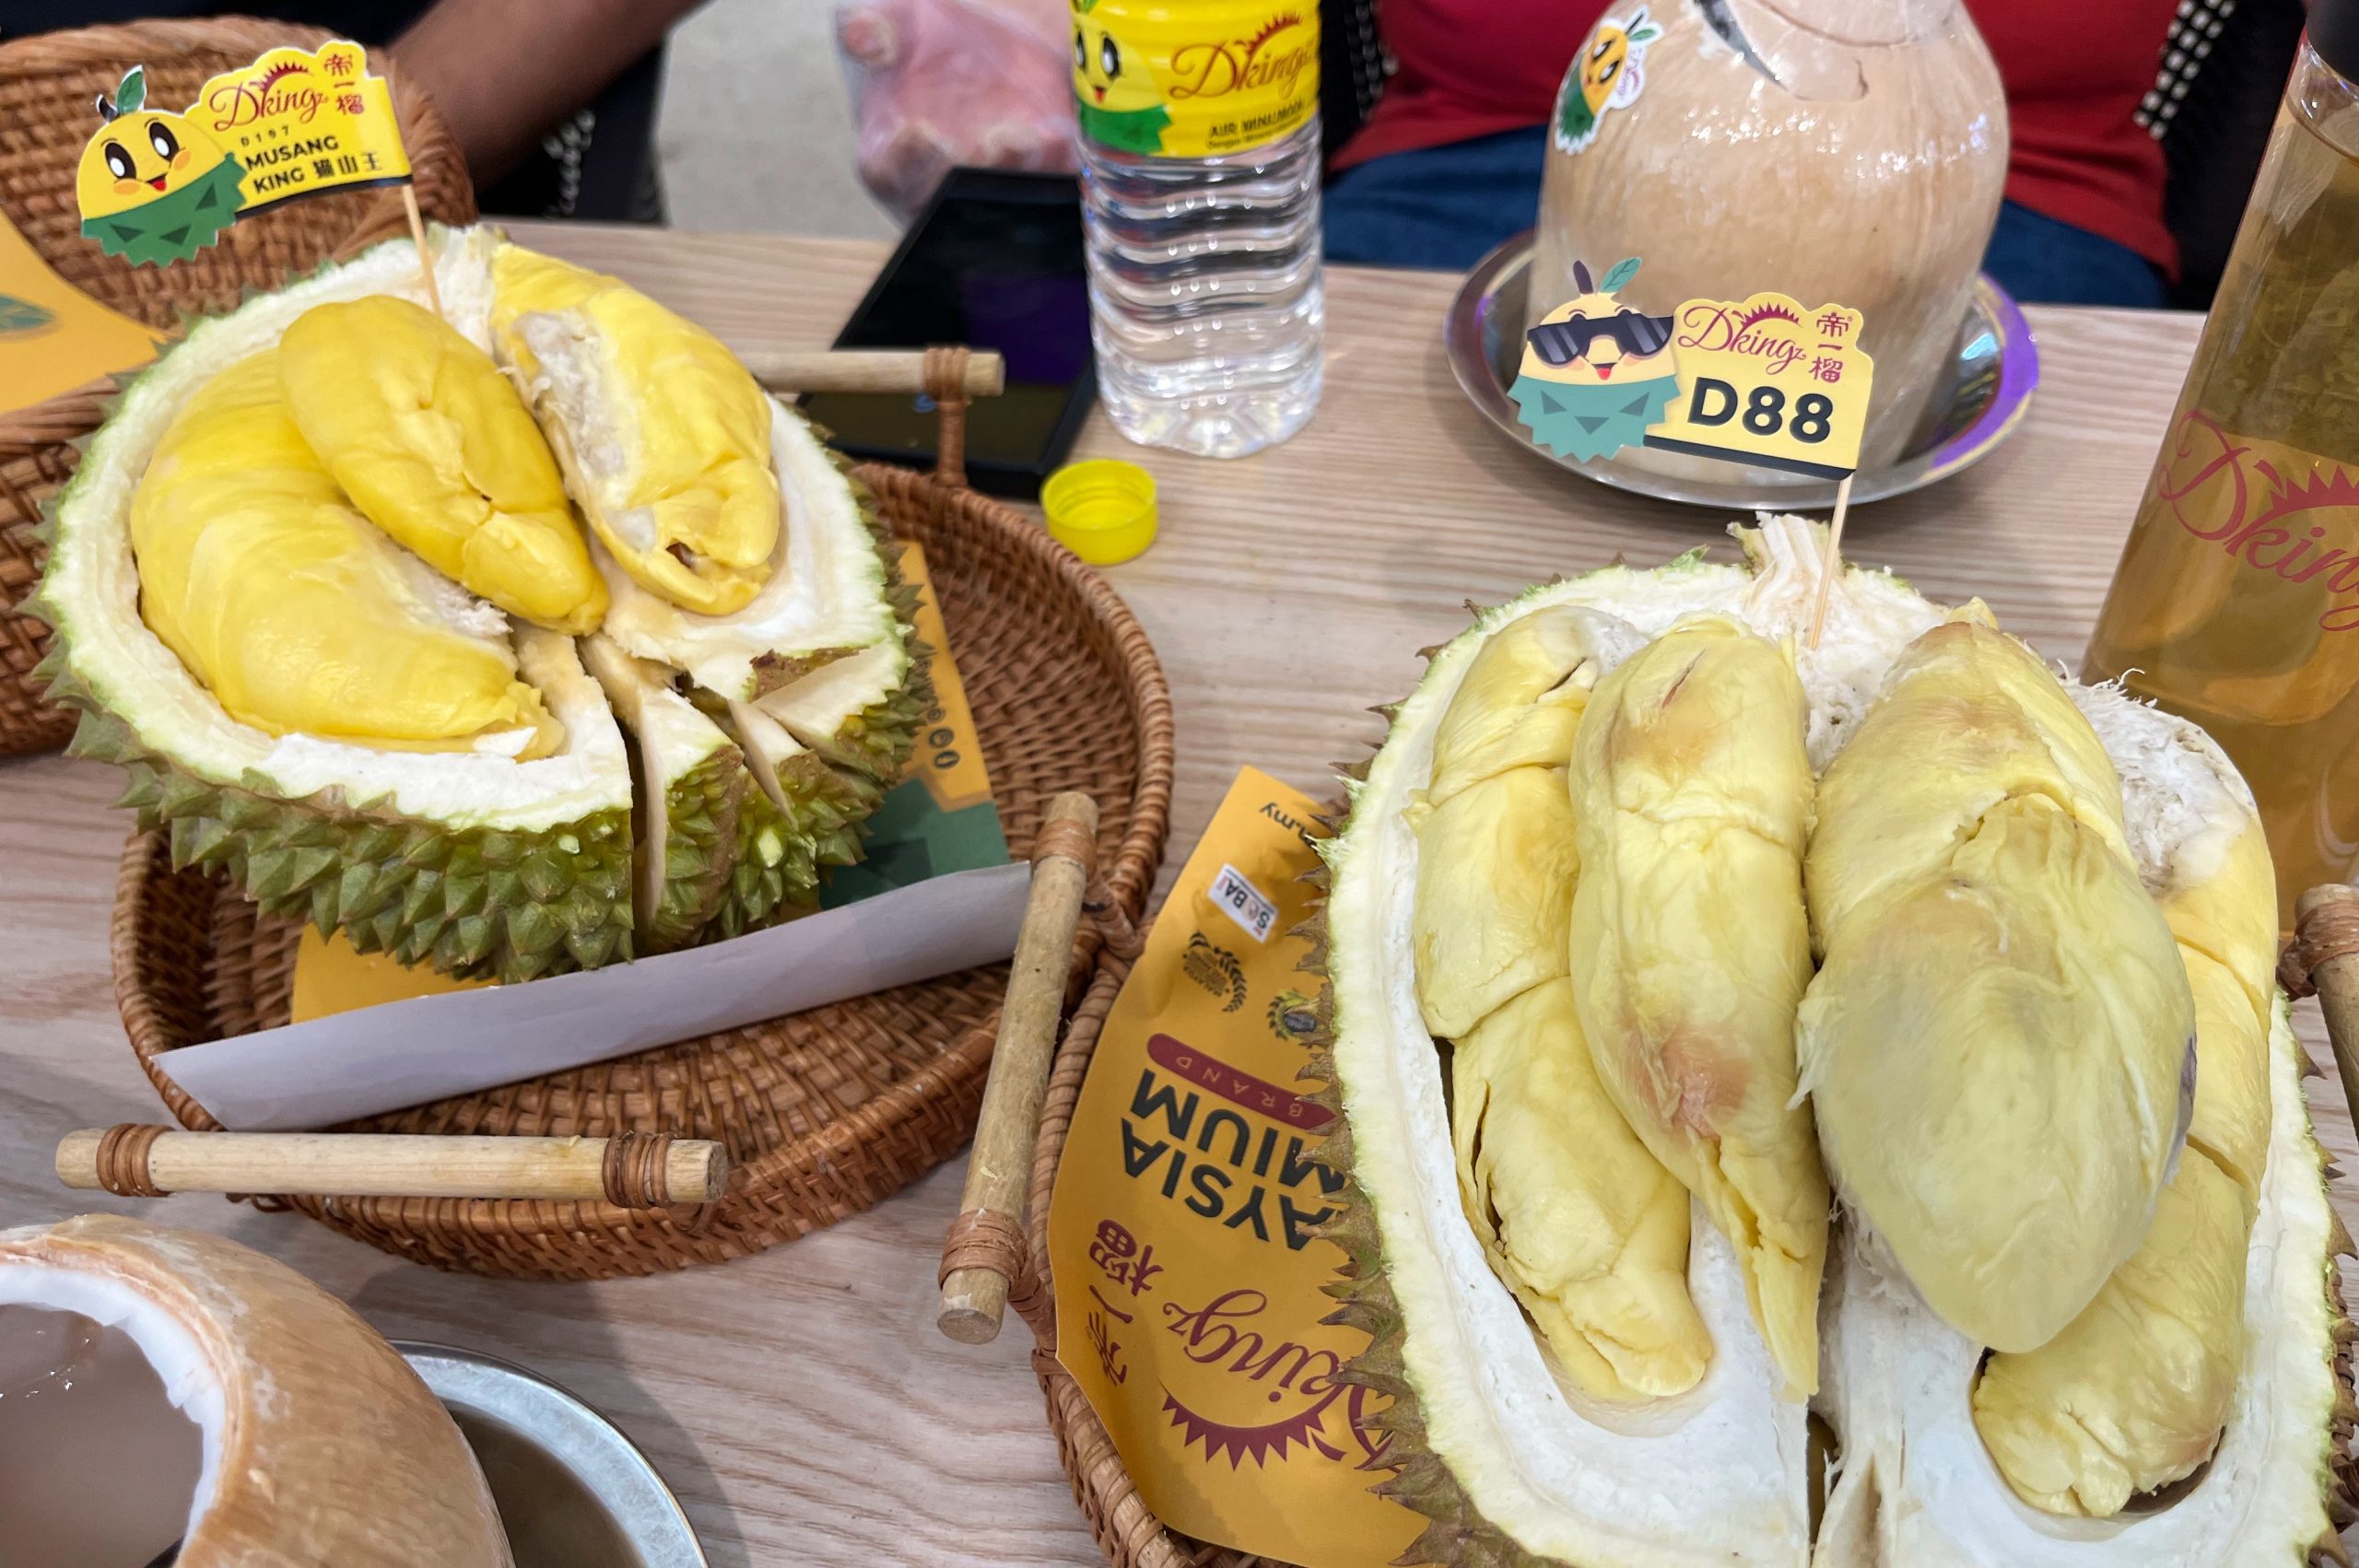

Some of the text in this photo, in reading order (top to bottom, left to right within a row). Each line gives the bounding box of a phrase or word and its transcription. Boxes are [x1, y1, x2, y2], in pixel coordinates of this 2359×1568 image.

[245, 135, 339, 170] MUSANG
[253, 168, 305, 194] KING
[1687, 377, 1834, 444] D88
[1174, 1054, 1304, 1119] BRAND
